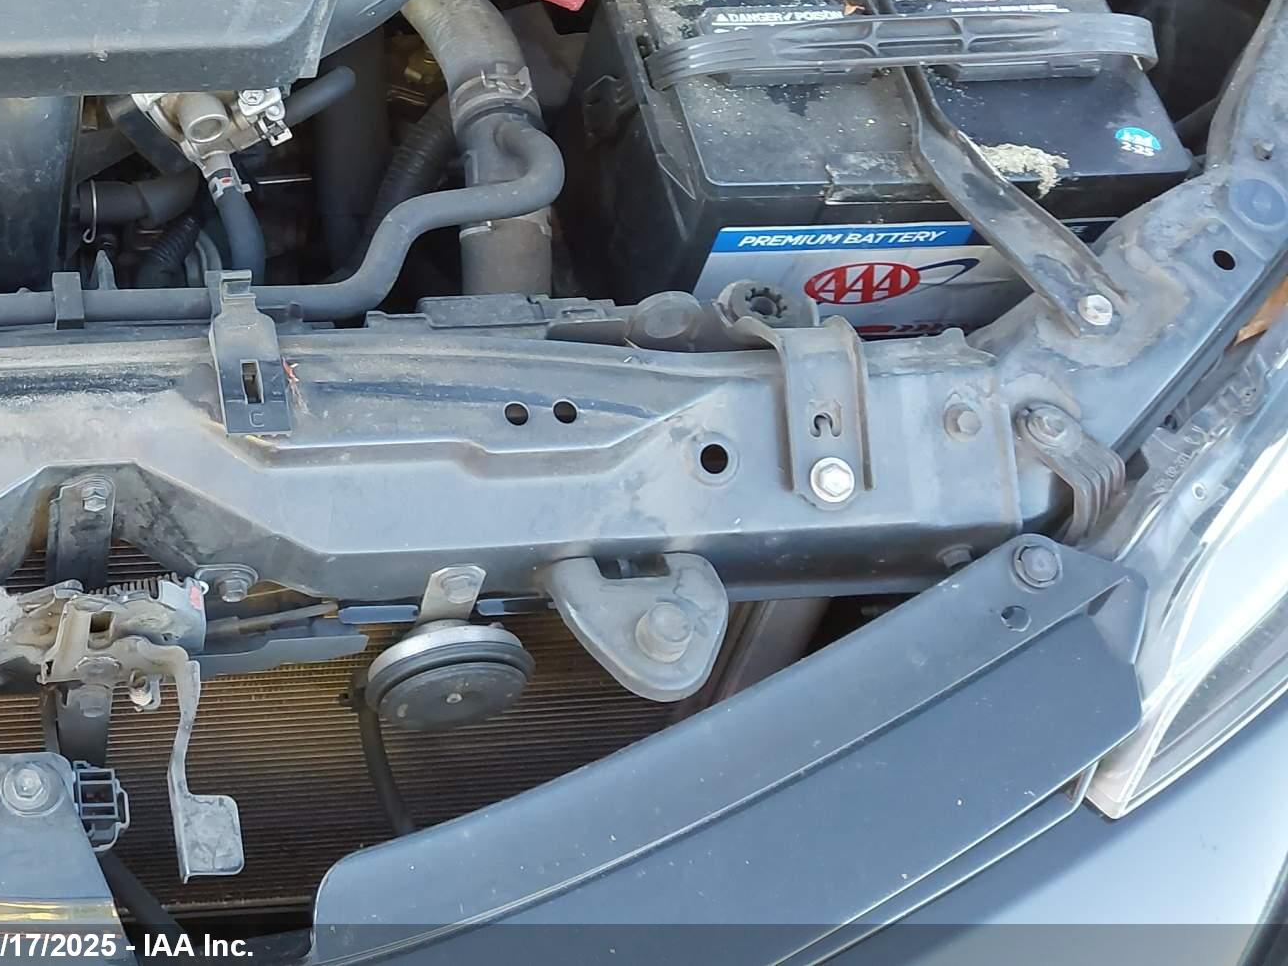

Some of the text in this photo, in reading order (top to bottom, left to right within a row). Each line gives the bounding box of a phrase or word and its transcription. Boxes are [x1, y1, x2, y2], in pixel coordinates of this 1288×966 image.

[728, 12, 782, 22] DANGER
[795, 10, 844, 21] POISON
[738, 231, 946, 247] PREMIUM BATTERY
[805, 263, 919, 304] AAA
